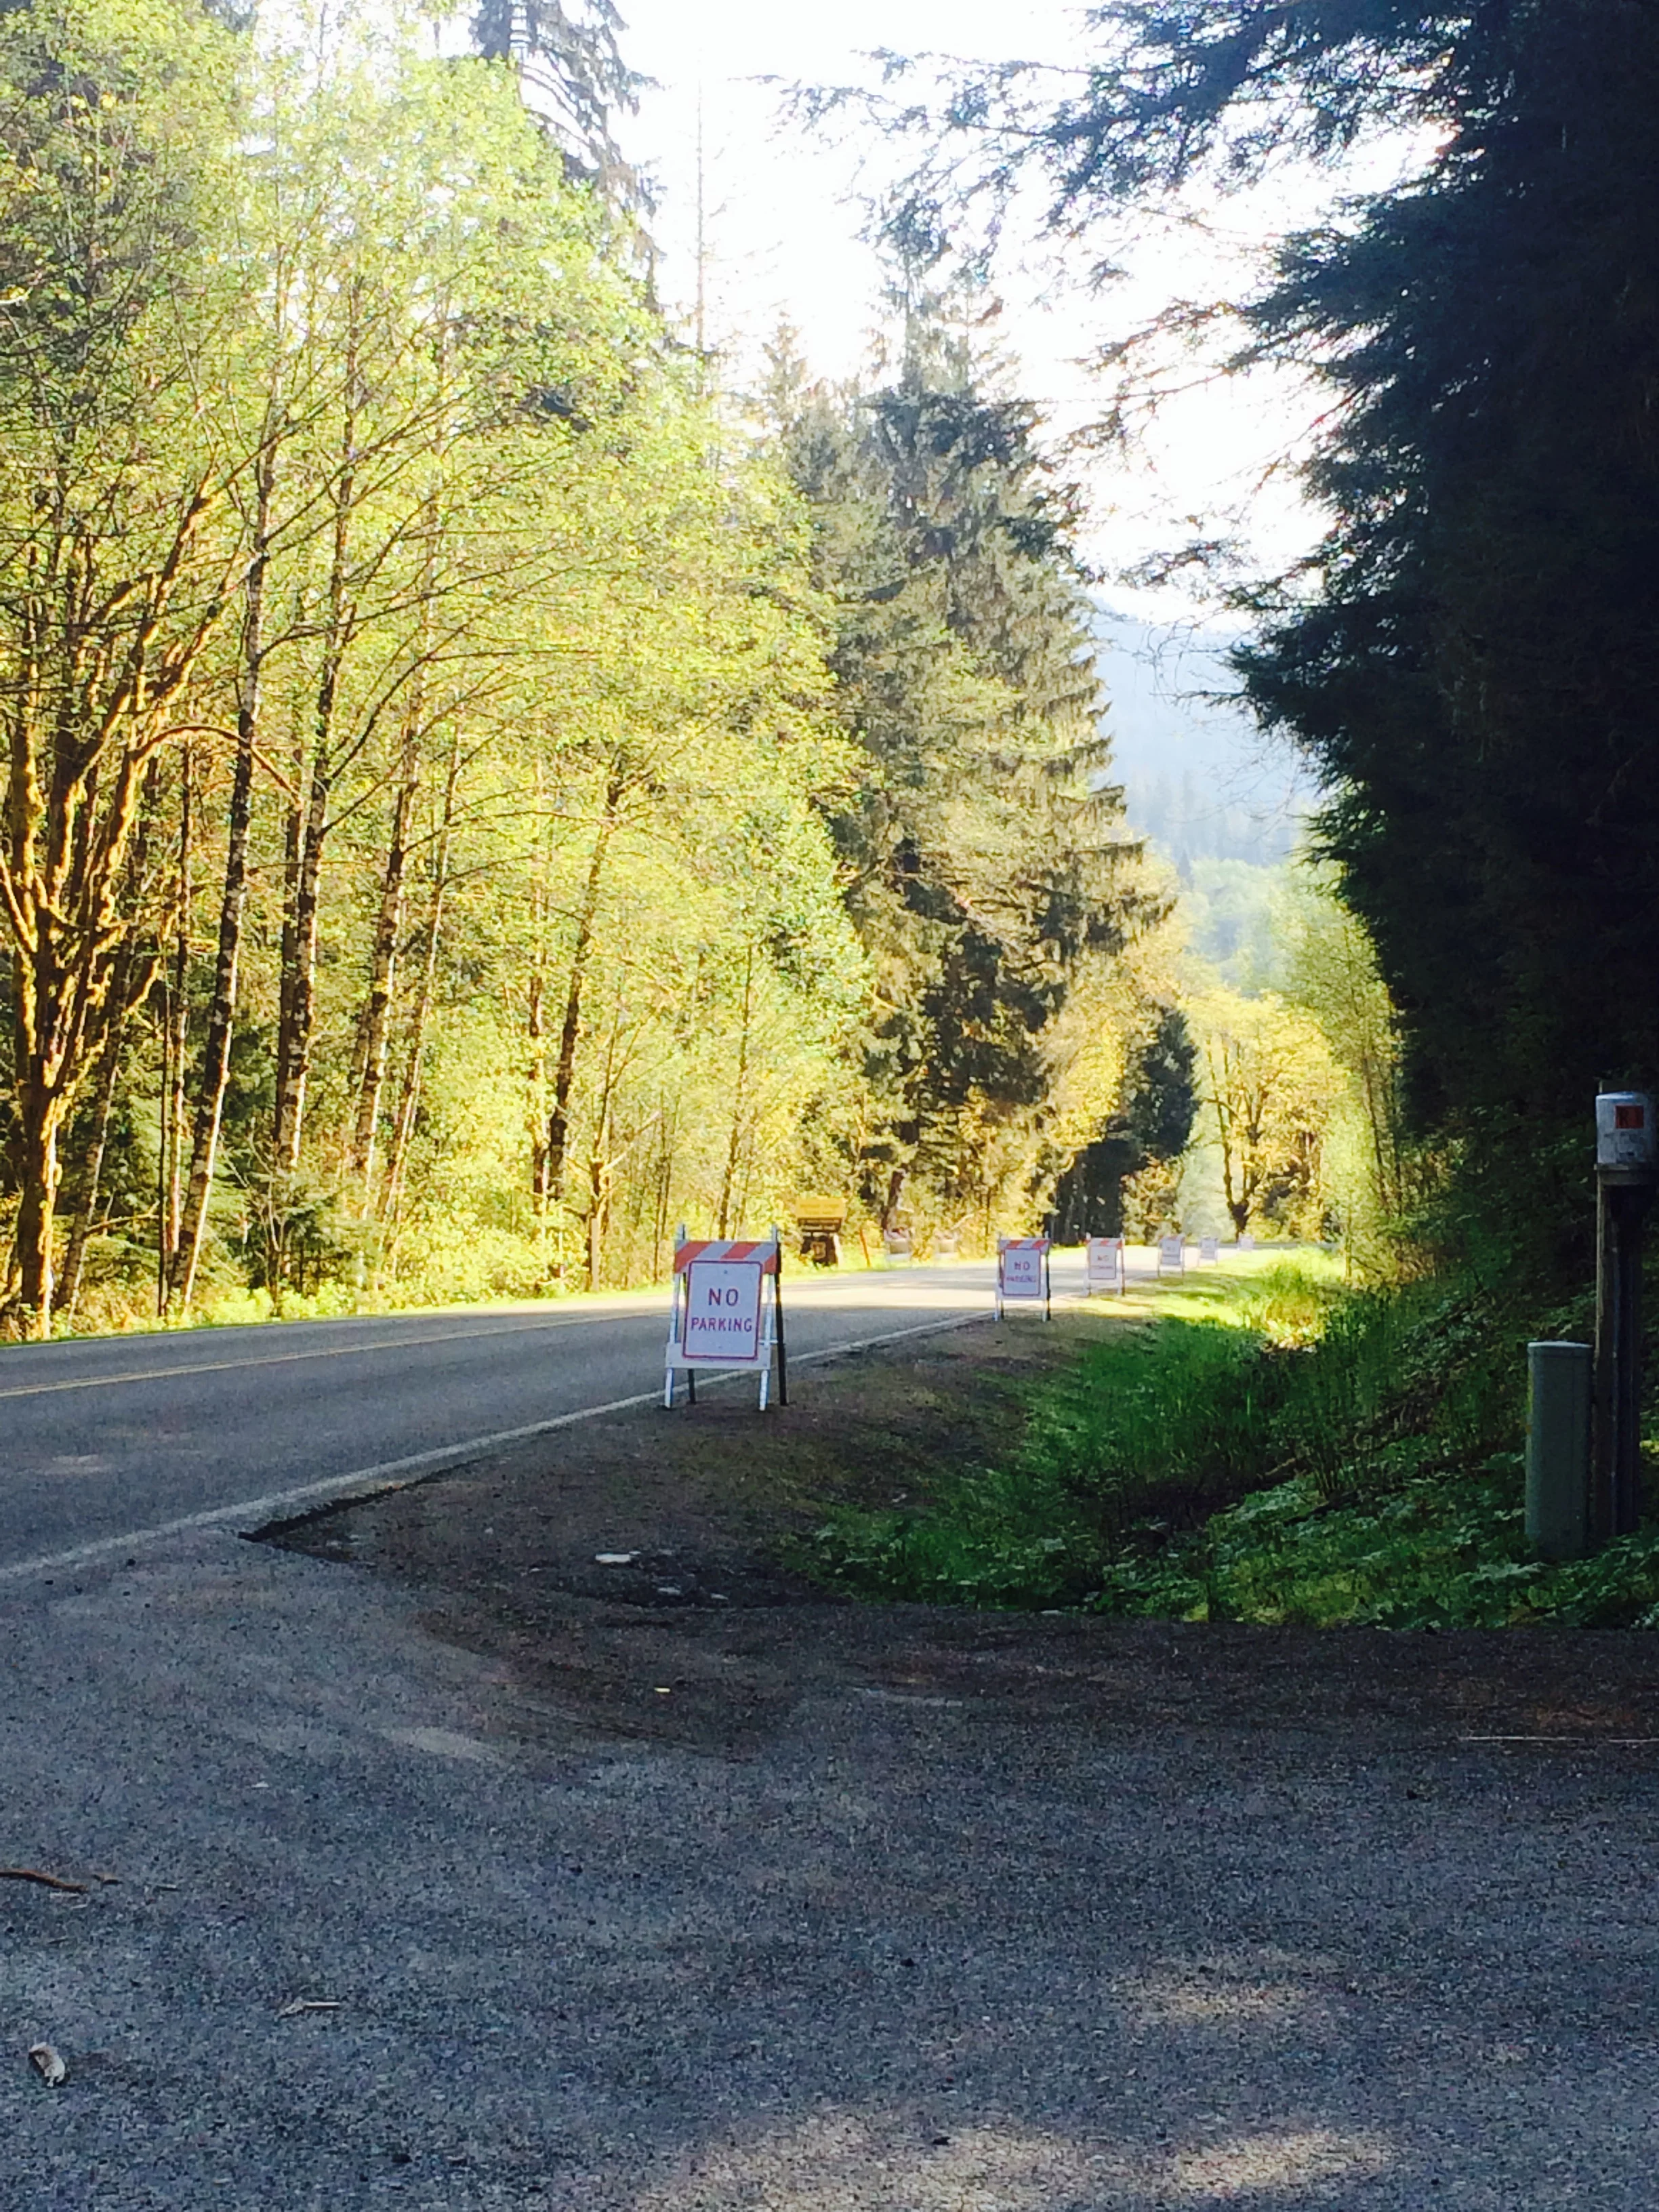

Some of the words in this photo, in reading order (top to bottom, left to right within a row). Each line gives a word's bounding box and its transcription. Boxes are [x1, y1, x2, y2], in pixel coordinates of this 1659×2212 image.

[1015, 1261, 1030, 1271] NO
[708, 1287, 739, 1307] NO
[691, 1317, 752, 1332] PARKING
